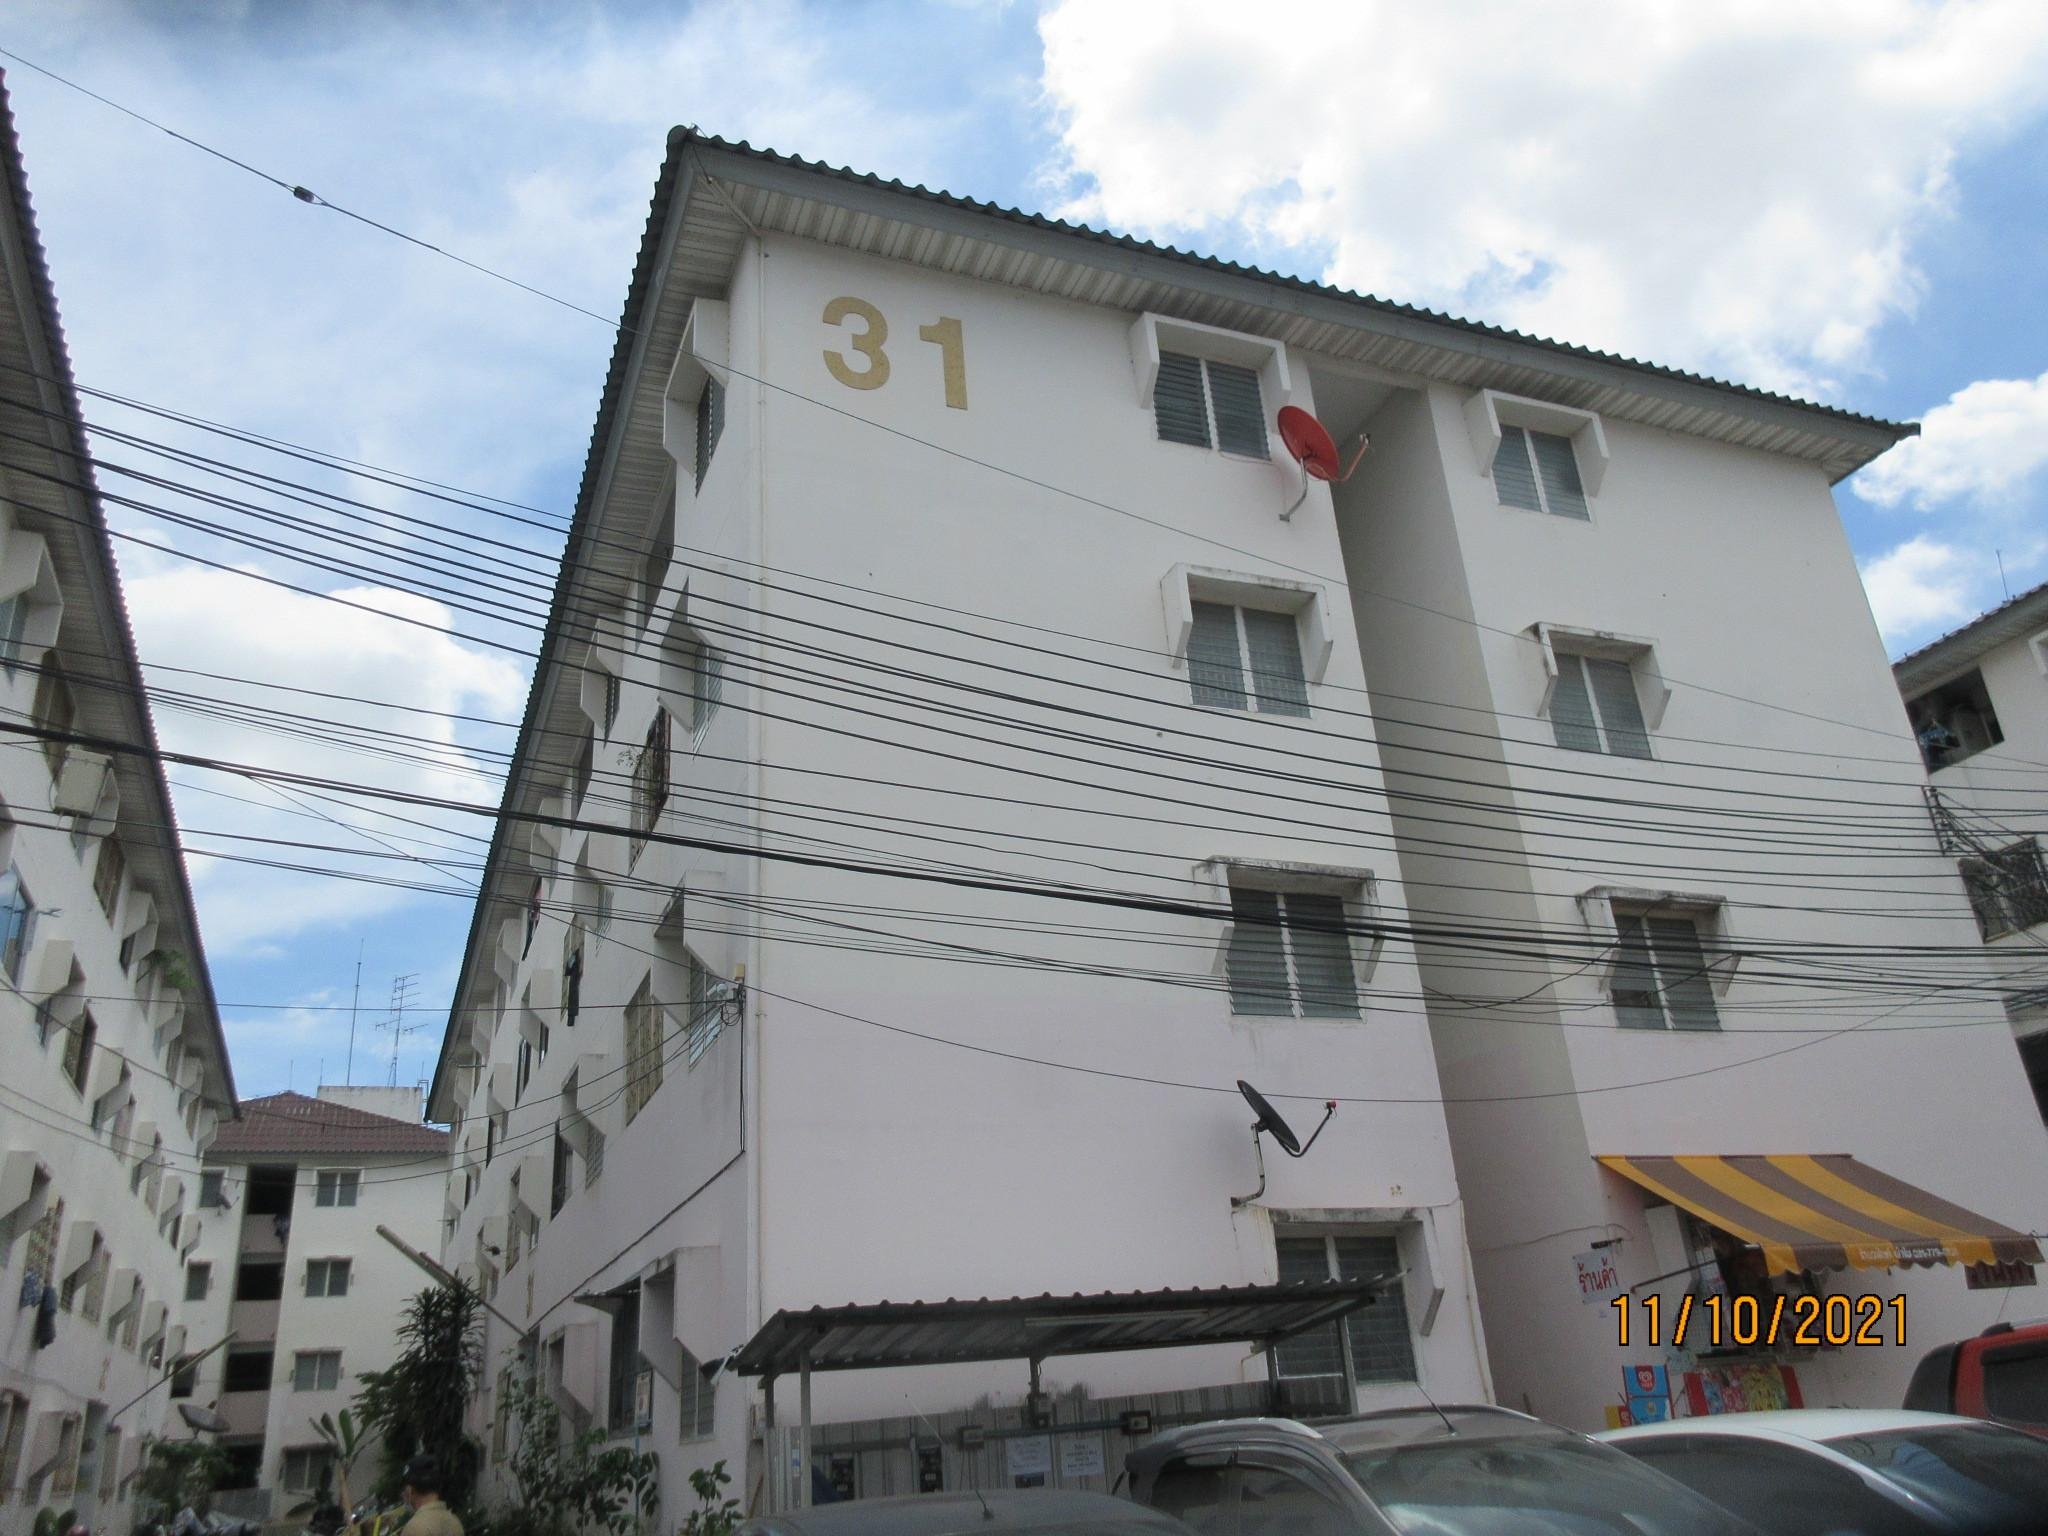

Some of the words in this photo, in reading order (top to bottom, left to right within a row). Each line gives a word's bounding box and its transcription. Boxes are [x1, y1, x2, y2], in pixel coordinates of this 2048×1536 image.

[822, 296, 968, 411] 31
[1577, 1257, 1619, 1293] ร้านค้า
